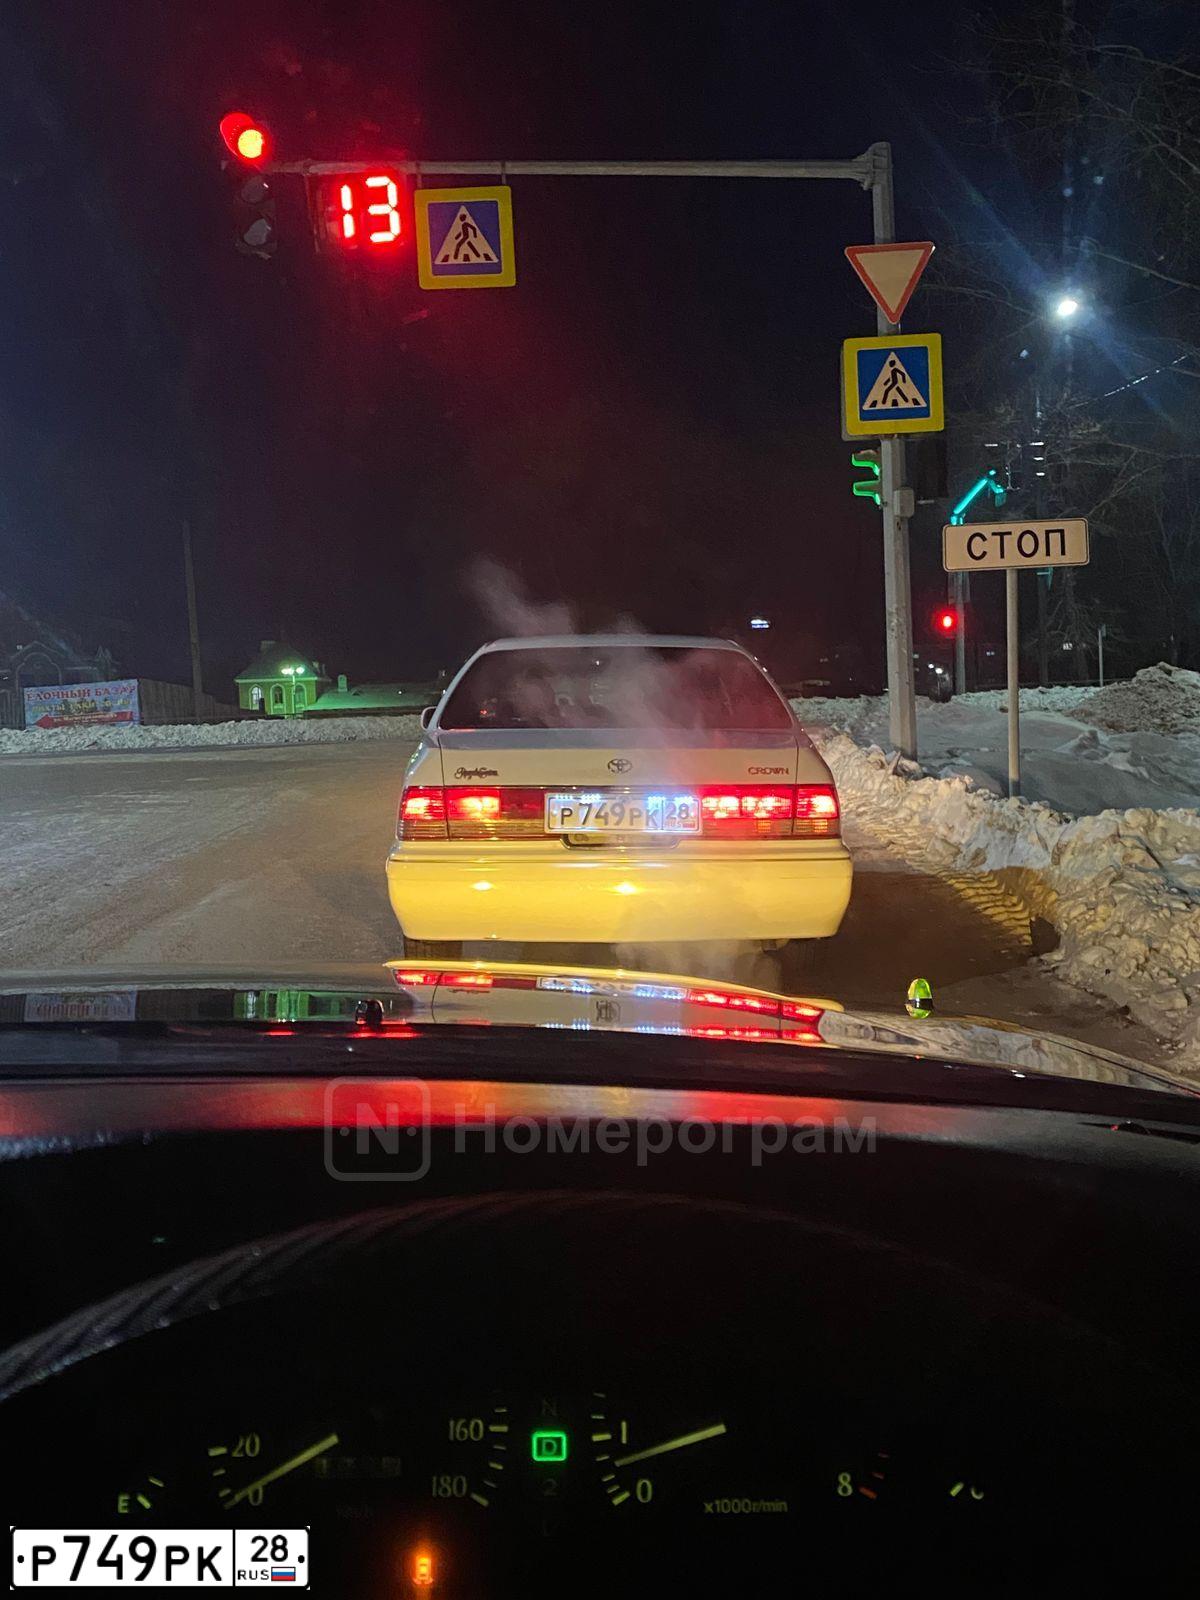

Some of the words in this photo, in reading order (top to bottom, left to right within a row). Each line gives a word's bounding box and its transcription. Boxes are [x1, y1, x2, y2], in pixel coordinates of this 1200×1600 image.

[340, 176, 400, 243] 13
[966, 529, 1066, 561] СТОП
[747, 766, 790, 775] CROWN
[665, 803, 690, 820] 28
[448, 1417, 484, 1440] 160
[232, 1433, 260, 1457] 20
[541, 1439, 558, 1456] D
[431, 1475, 468, 1498] 180
[635, 1479, 653, 1503] 0
[837, 1472, 853, 1496] 8
[117, 1494, 130, 1513] E
